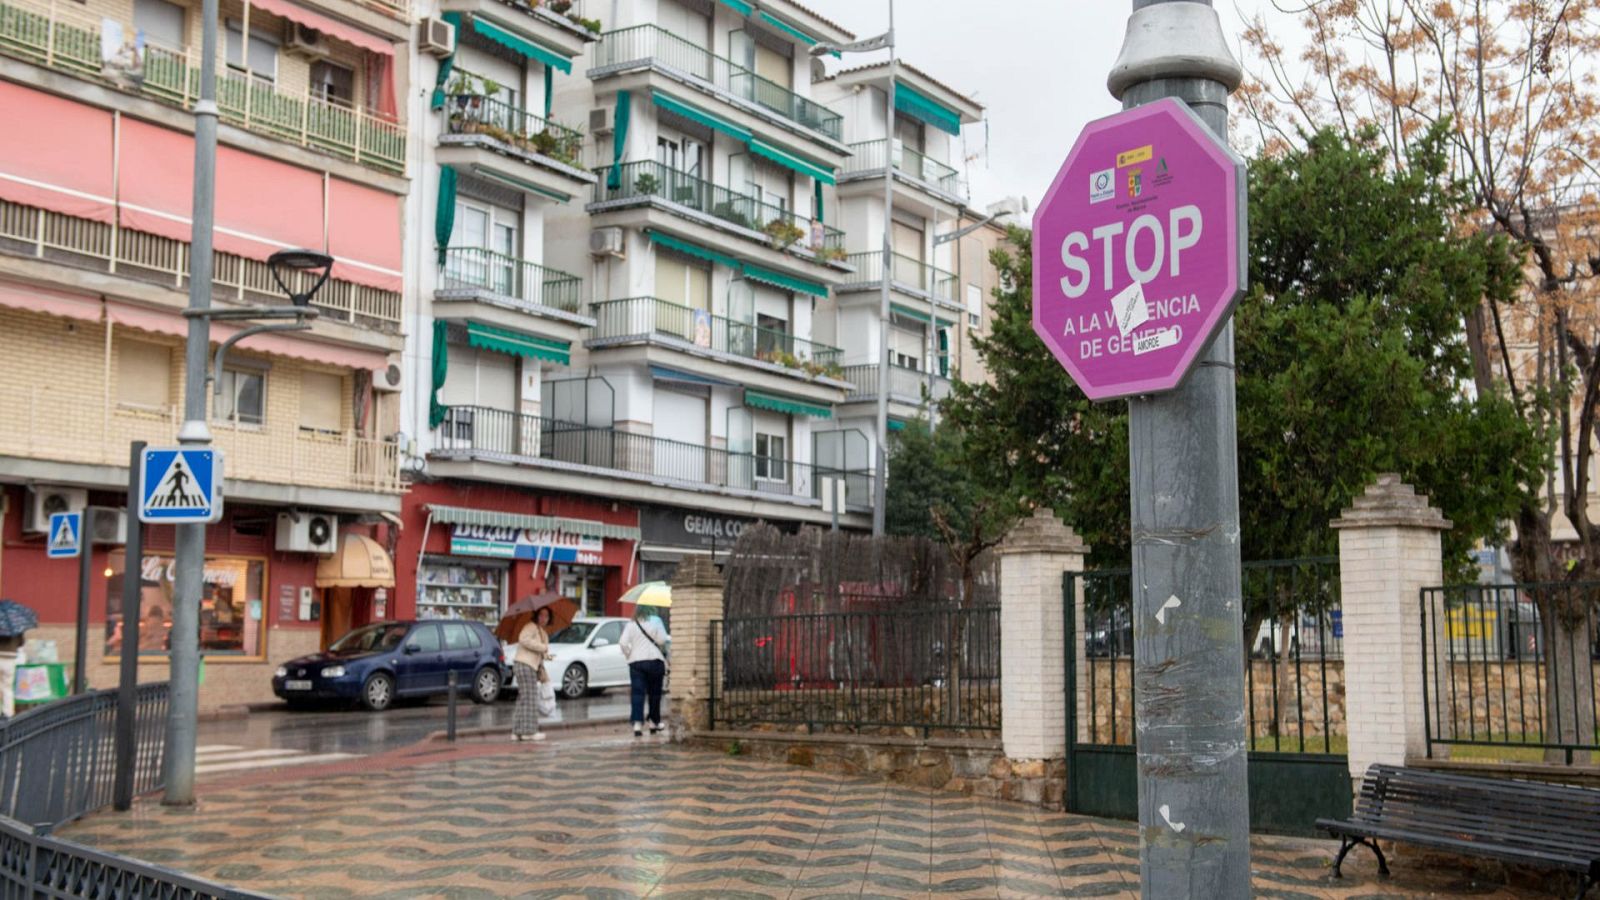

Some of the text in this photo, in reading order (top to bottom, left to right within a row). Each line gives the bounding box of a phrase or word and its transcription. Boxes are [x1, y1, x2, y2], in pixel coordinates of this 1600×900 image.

[1060, 204, 1203, 299] STOP
[1063, 318, 1076, 337] A
[1080, 312, 1101, 334] LA
[1105, 293, 1201, 329] VENCIA
[1080, 338, 1103, 360] DE
[684, 514, 723, 538] GEMA
